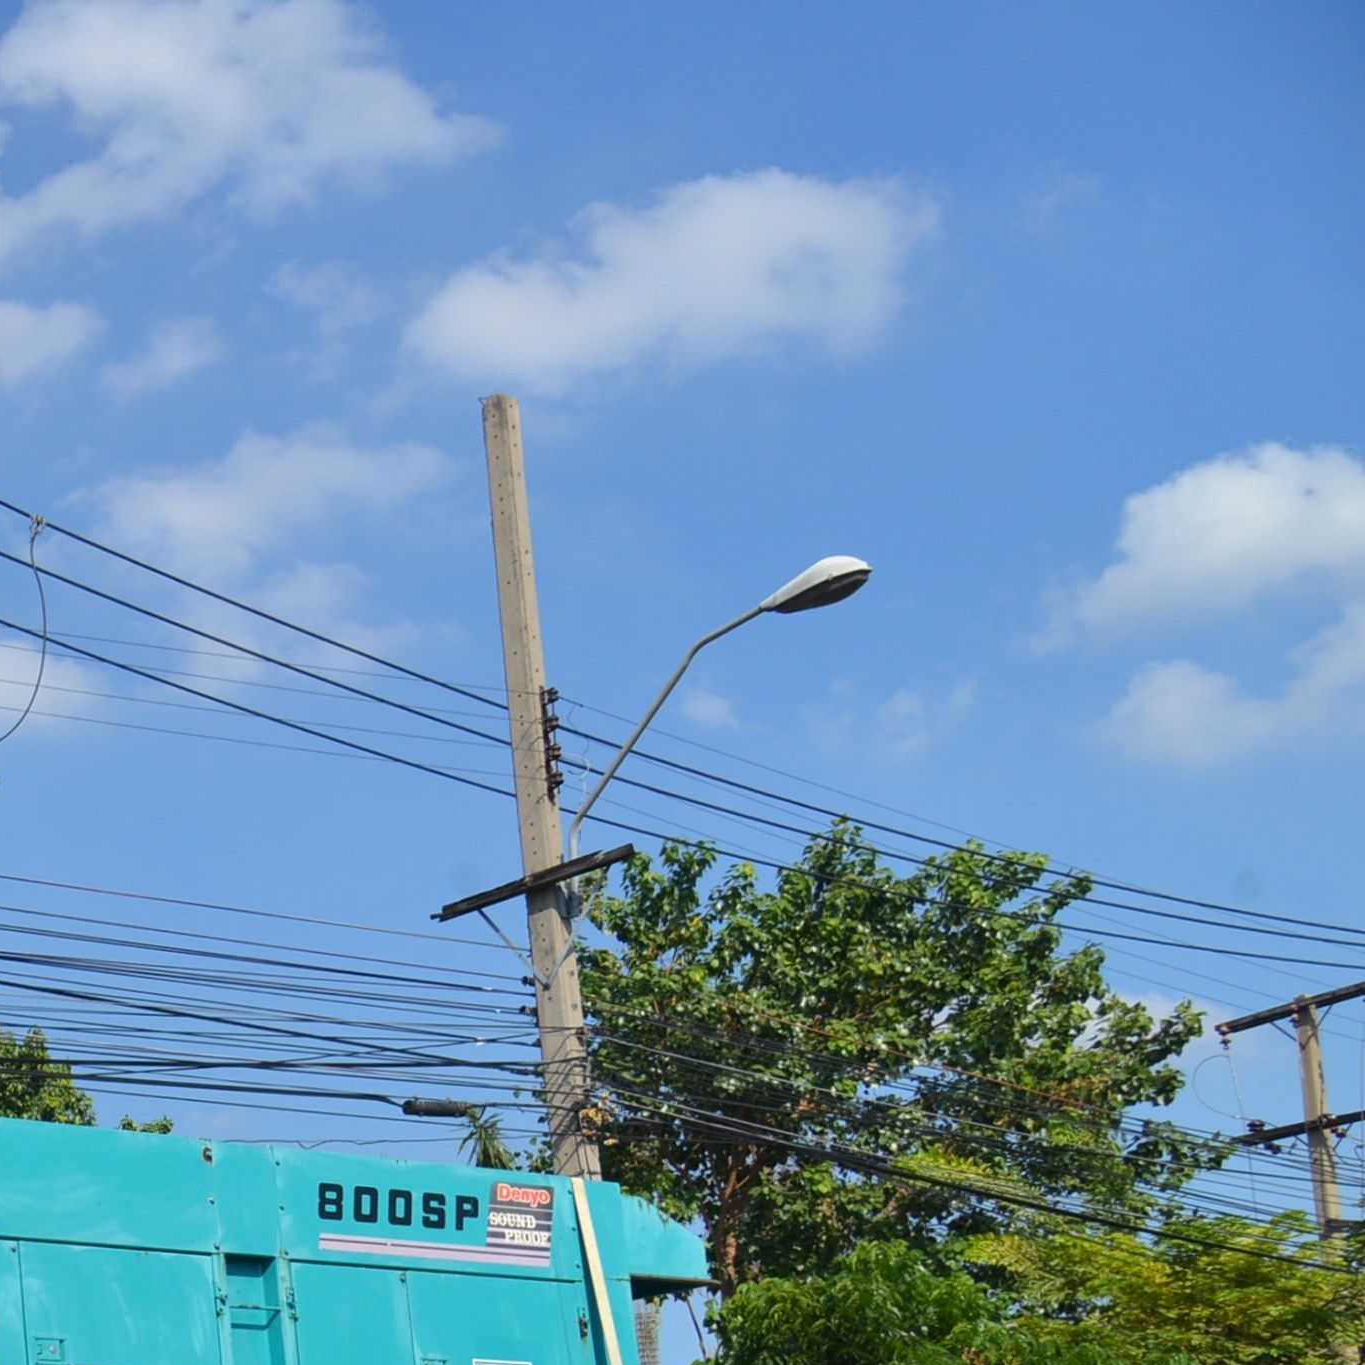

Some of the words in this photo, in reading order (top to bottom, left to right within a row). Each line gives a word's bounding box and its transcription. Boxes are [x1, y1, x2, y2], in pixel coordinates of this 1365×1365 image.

[497, 1183, 550, 1207] Denyo
[318, 1182, 479, 1231] 800SP
[489, 1212, 537, 1229] SOUND
[504, 1230, 550, 1245] PROOF
